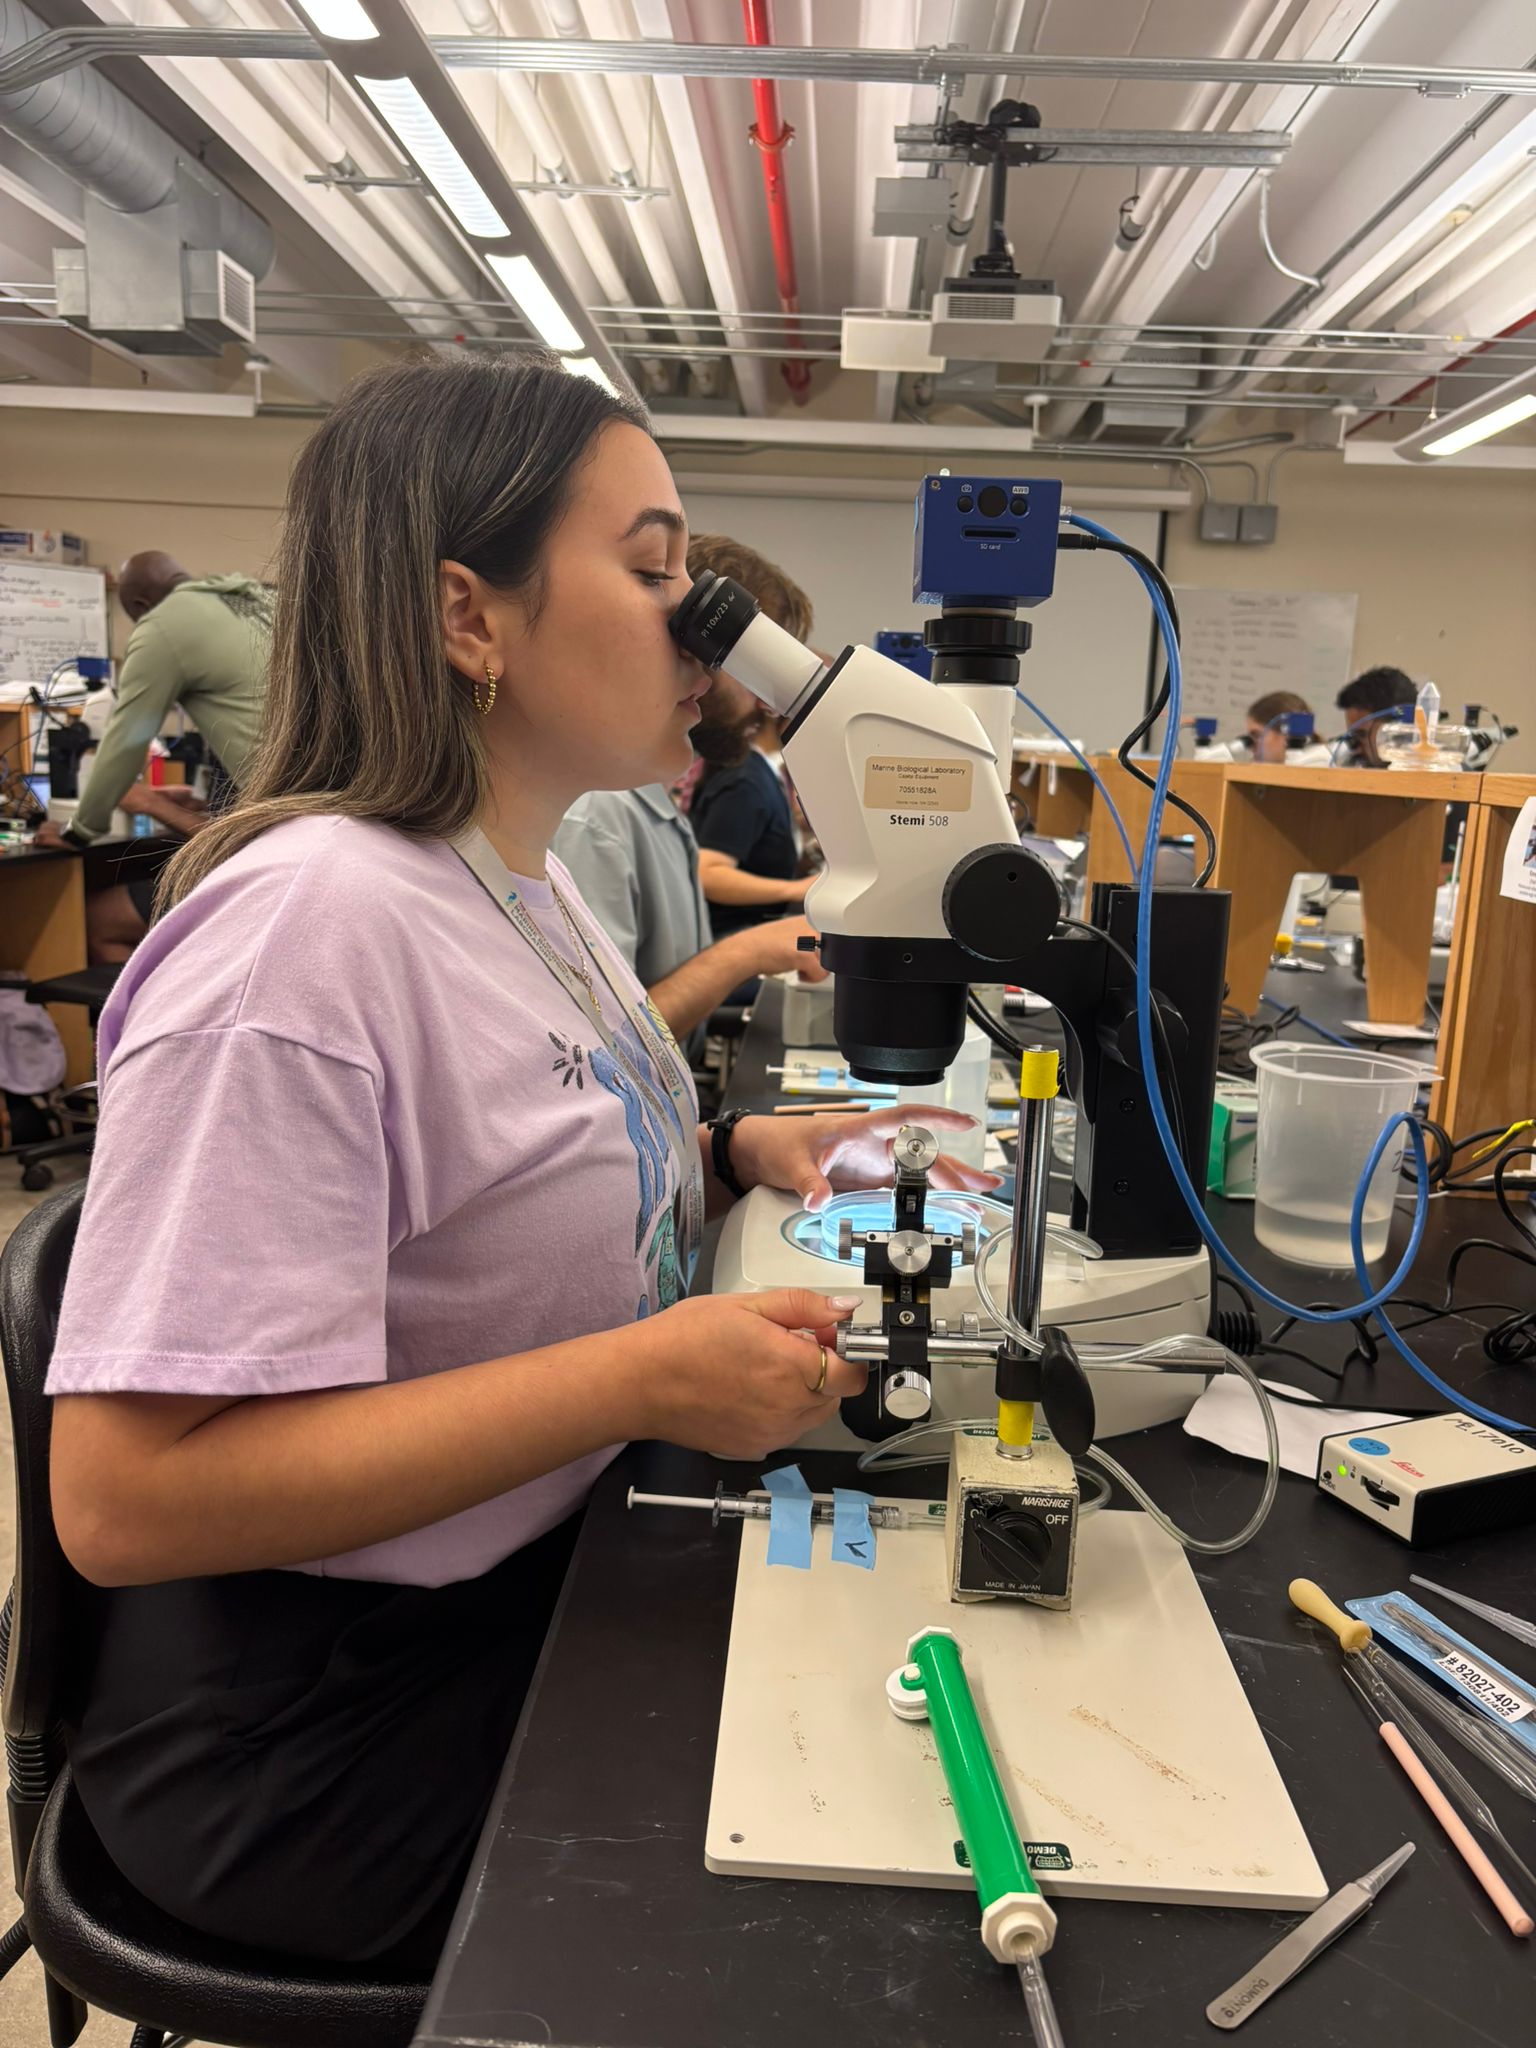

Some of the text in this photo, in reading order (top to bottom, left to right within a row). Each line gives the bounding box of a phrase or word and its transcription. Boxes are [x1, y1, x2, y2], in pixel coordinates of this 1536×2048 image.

[707, 603, 729, 632] 10x/23
[872, 764, 966, 776] Marine Biological Laboratory
[890, 814, 949, 826] Stemi 508
[1021, 1496, 1072, 1509] NARISHIGE
[1045, 1513, 1070, 1526] OFF
[985, 1581, 1005, 1589] MADE
[1018, 1583, 1041, 1591] JAPAN
[1456, 1663, 1521, 1714] 82027-402
[1026, 1845, 1056, 1854] DEMO
